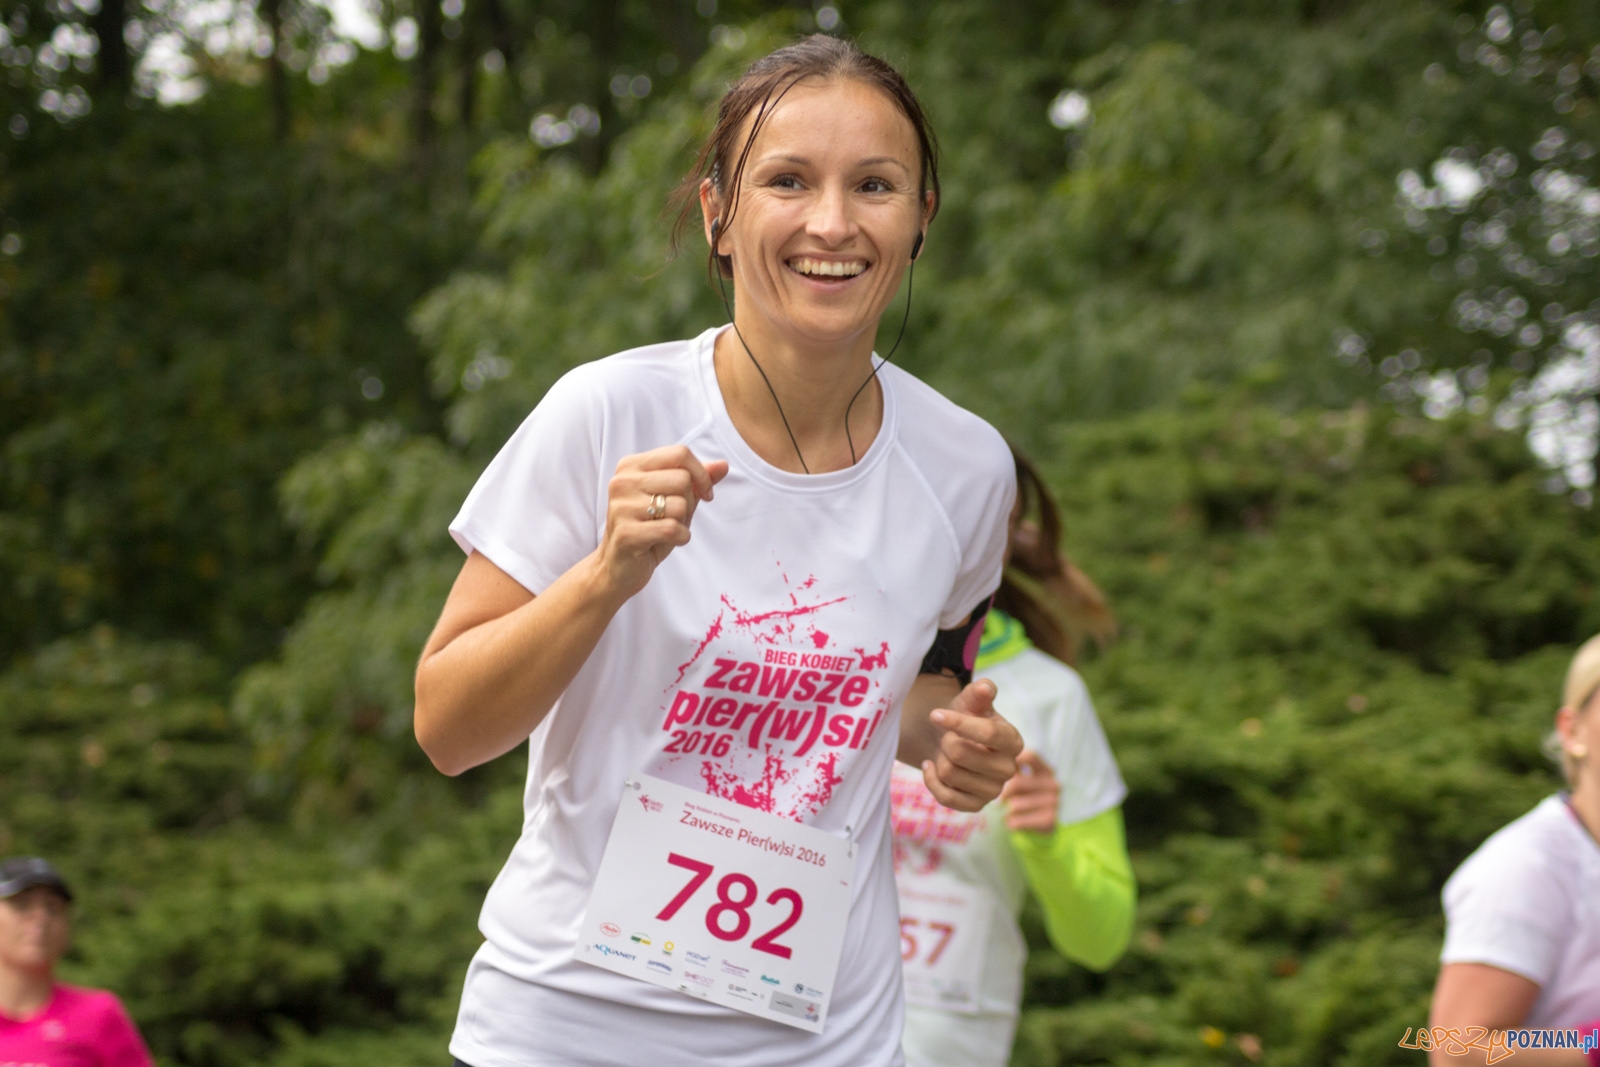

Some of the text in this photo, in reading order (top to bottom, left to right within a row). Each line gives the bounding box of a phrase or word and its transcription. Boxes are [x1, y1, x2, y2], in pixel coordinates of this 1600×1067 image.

[764, 648, 856, 672] BIEG KOBIET
[703, 658, 871, 707] zawsze
[662, 730, 733, 757] 2016
[679, 810, 827, 868] Zawsze Pier(w)si 2016
[655, 852, 804, 960] 782
[593, 943, 637, 961] AQUANET
